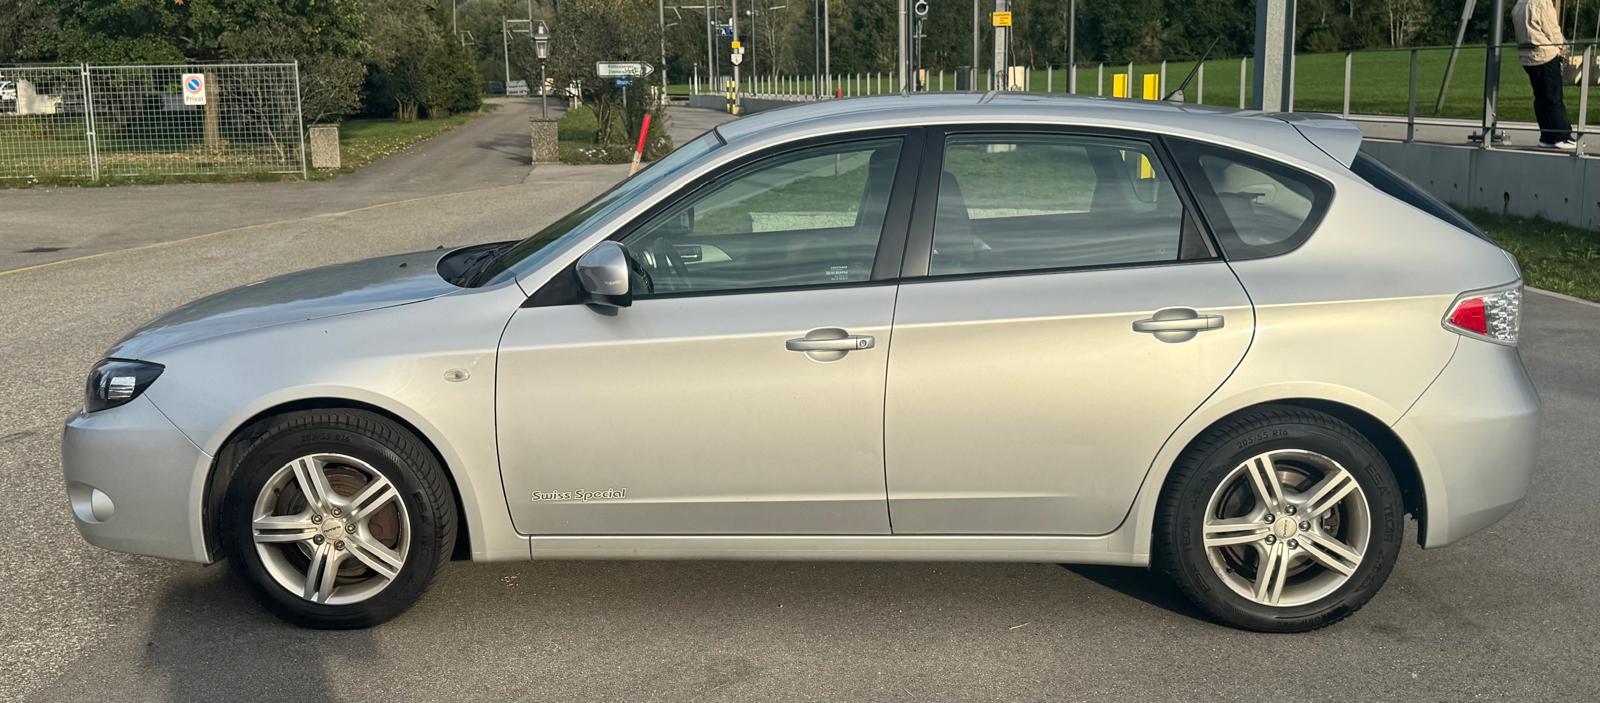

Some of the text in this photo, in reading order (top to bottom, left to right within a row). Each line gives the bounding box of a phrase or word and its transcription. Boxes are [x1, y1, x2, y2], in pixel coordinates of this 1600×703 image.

[1238, 429, 1289, 449] 205/55 R16
[532, 487, 627, 502] Swiss Special
